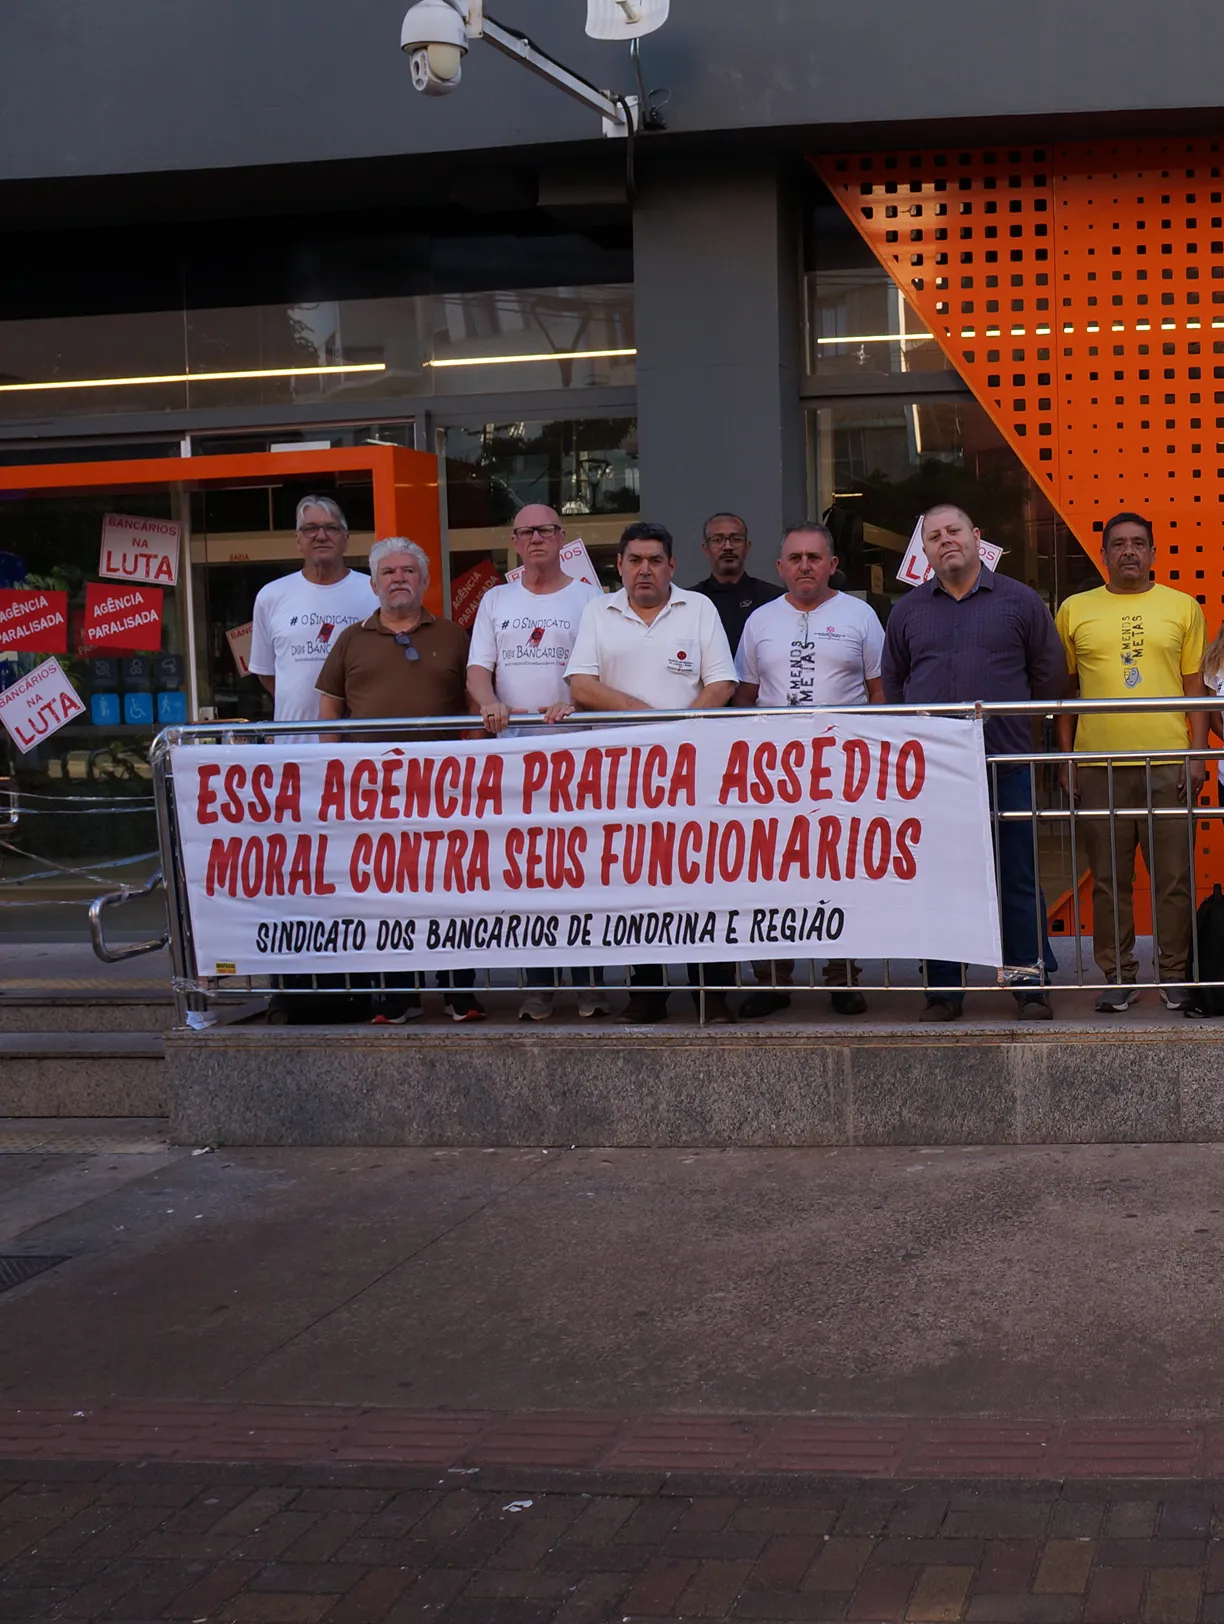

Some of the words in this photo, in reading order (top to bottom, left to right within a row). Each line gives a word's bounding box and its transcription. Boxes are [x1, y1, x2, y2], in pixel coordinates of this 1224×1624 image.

[108, 517, 177, 536] BANCÁRIOS
[132, 538, 148, 548] NA
[106, 551, 173, 581] LUTA
[94, 592, 144, 617] AGÊNCIA
[451, 571, 481, 610] AGÊNCIA
[0, 595, 48, 623] AGÊNCIA
[88, 609, 159, 640] PARALISADA
[0, 612, 64, 644] ARALISADA
[1121, 615, 1131, 650] MENOS
[1132, 615, 1144, 658] METAS
[790, 640, 802, 690] MENOS
[26, 693, 43, 708] NA
[14, 691, 81, 745] LUTA
[197, 763, 301, 825] ESSA
[318, 748, 504, 822] AGÊNCIA
[522, 742, 697, 815] PRATICA
[718, 725, 926, 805] ASSÉDIO
[205, 833, 336, 899] MORAL
[349, 829, 490, 894] CONTRA
[503, 825, 588, 890] SEUS
[600, 808, 922, 887] FUNCIONÁRIOS
[256, 918, 367, 954] SINDICATO
[376, 919, 416, 951] DOS
[426, 911, 559, 950] BANCÁRIOS
[566, 913, 593, 947] DE
[602, 911, 717, 947] LONDRINA
[725, 909, 740, 944] E
[749, 899, 845, 944] REGIÃO
